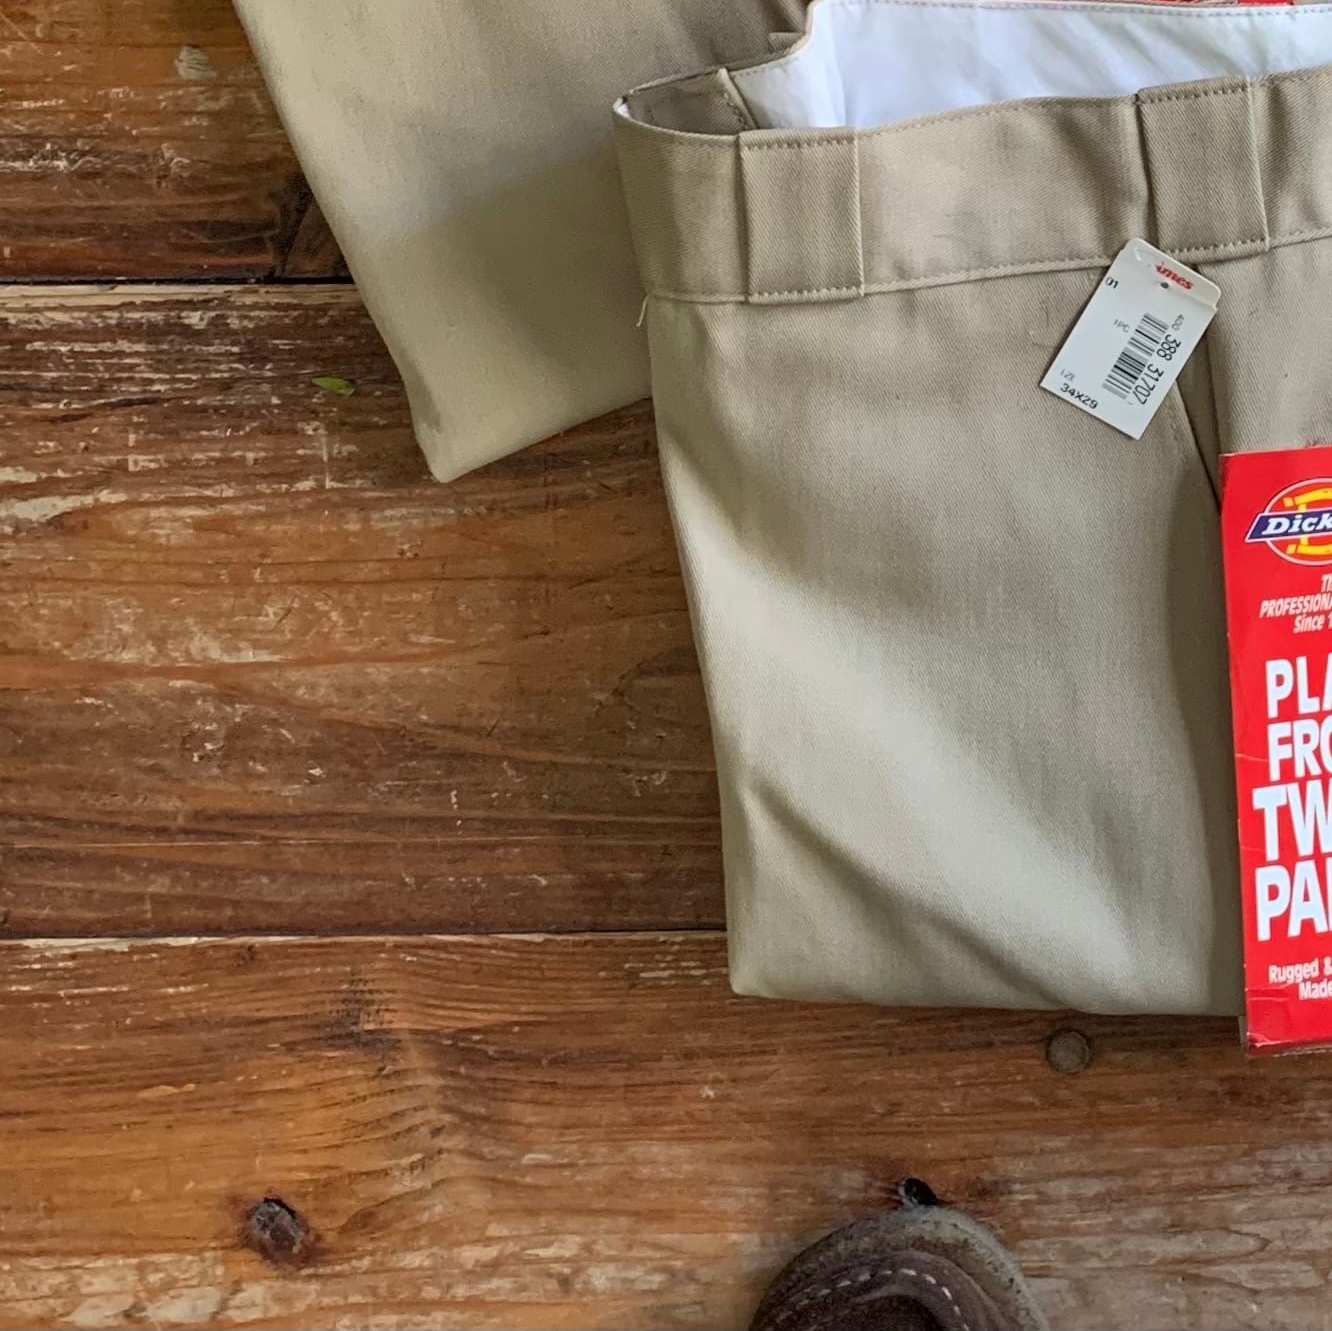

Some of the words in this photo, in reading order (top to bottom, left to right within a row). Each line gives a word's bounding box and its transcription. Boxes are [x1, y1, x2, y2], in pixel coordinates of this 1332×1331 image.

[1105, 276, 1119, 289] 01
[1156, 334, 1182, 362] 388
[1060, 382, 1099, 410] 34X29
[1134, 363, 1164, 405] 31707
[1293, 612, 1326, 634] Since
[1268, 956, 1320, 985] Rugged
